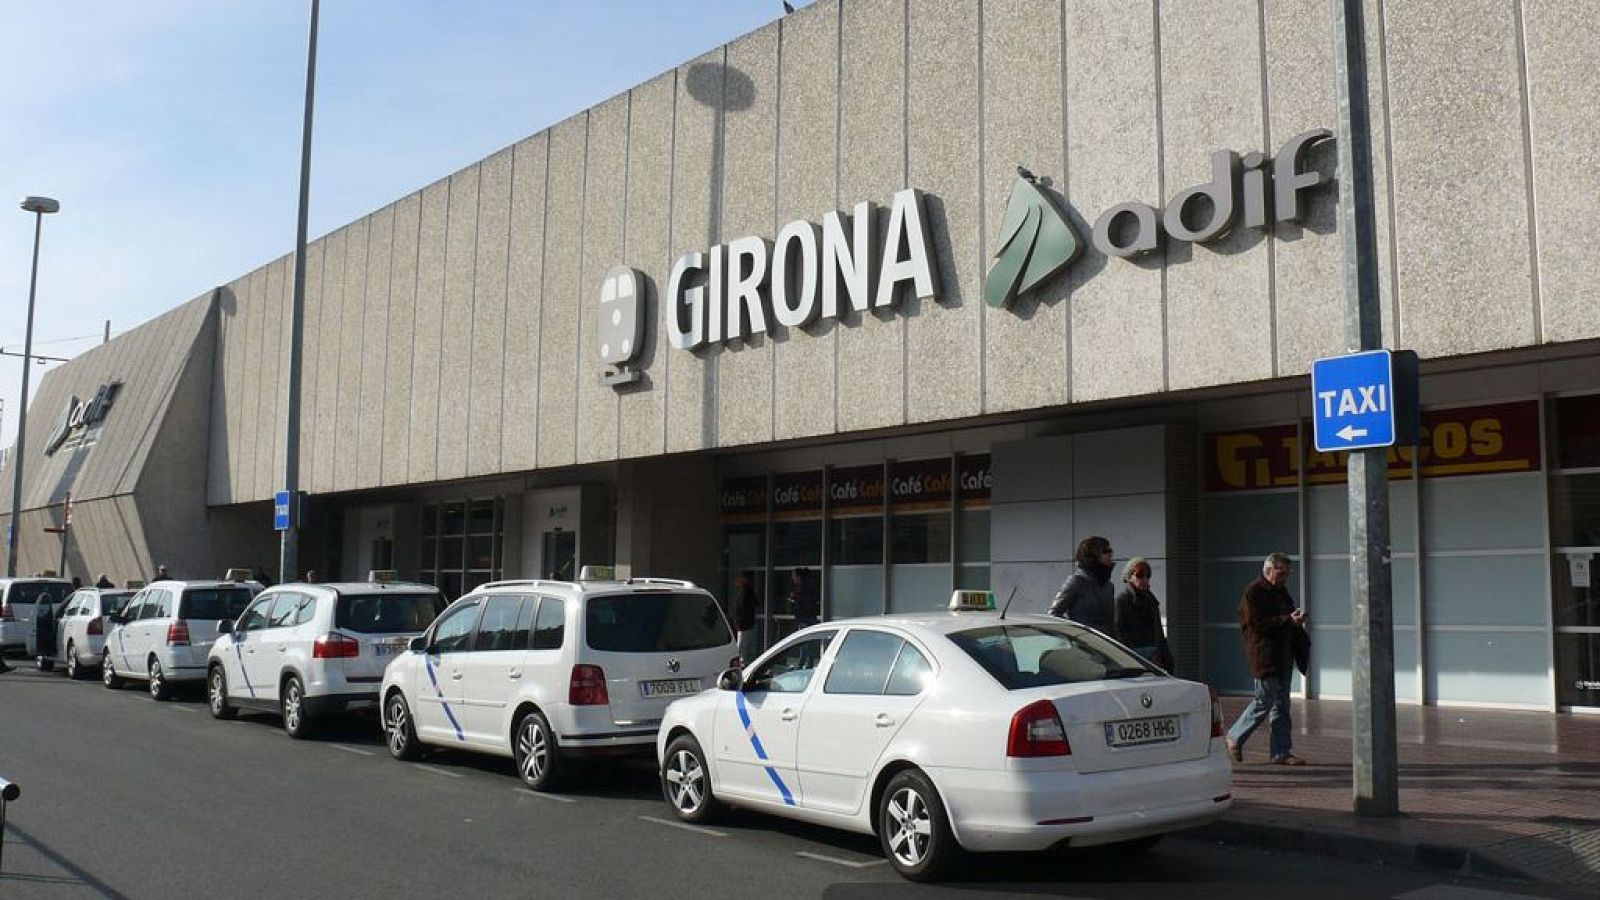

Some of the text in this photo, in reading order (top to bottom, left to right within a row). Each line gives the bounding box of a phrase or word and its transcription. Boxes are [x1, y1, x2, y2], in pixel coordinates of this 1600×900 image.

[1092, 128, 1333, 256] adif
[667, 188, 934, 350] GIRONA
[1318, 384, 1386, 418] TAXI
[774, 483, 799, 504] Café
[831, 479, 857, 500] Café
[892, 474, 922, 496] Café
[650, 681, 676, 695] 7009
[1118, 719, 1175, 741] 0268 HHG
